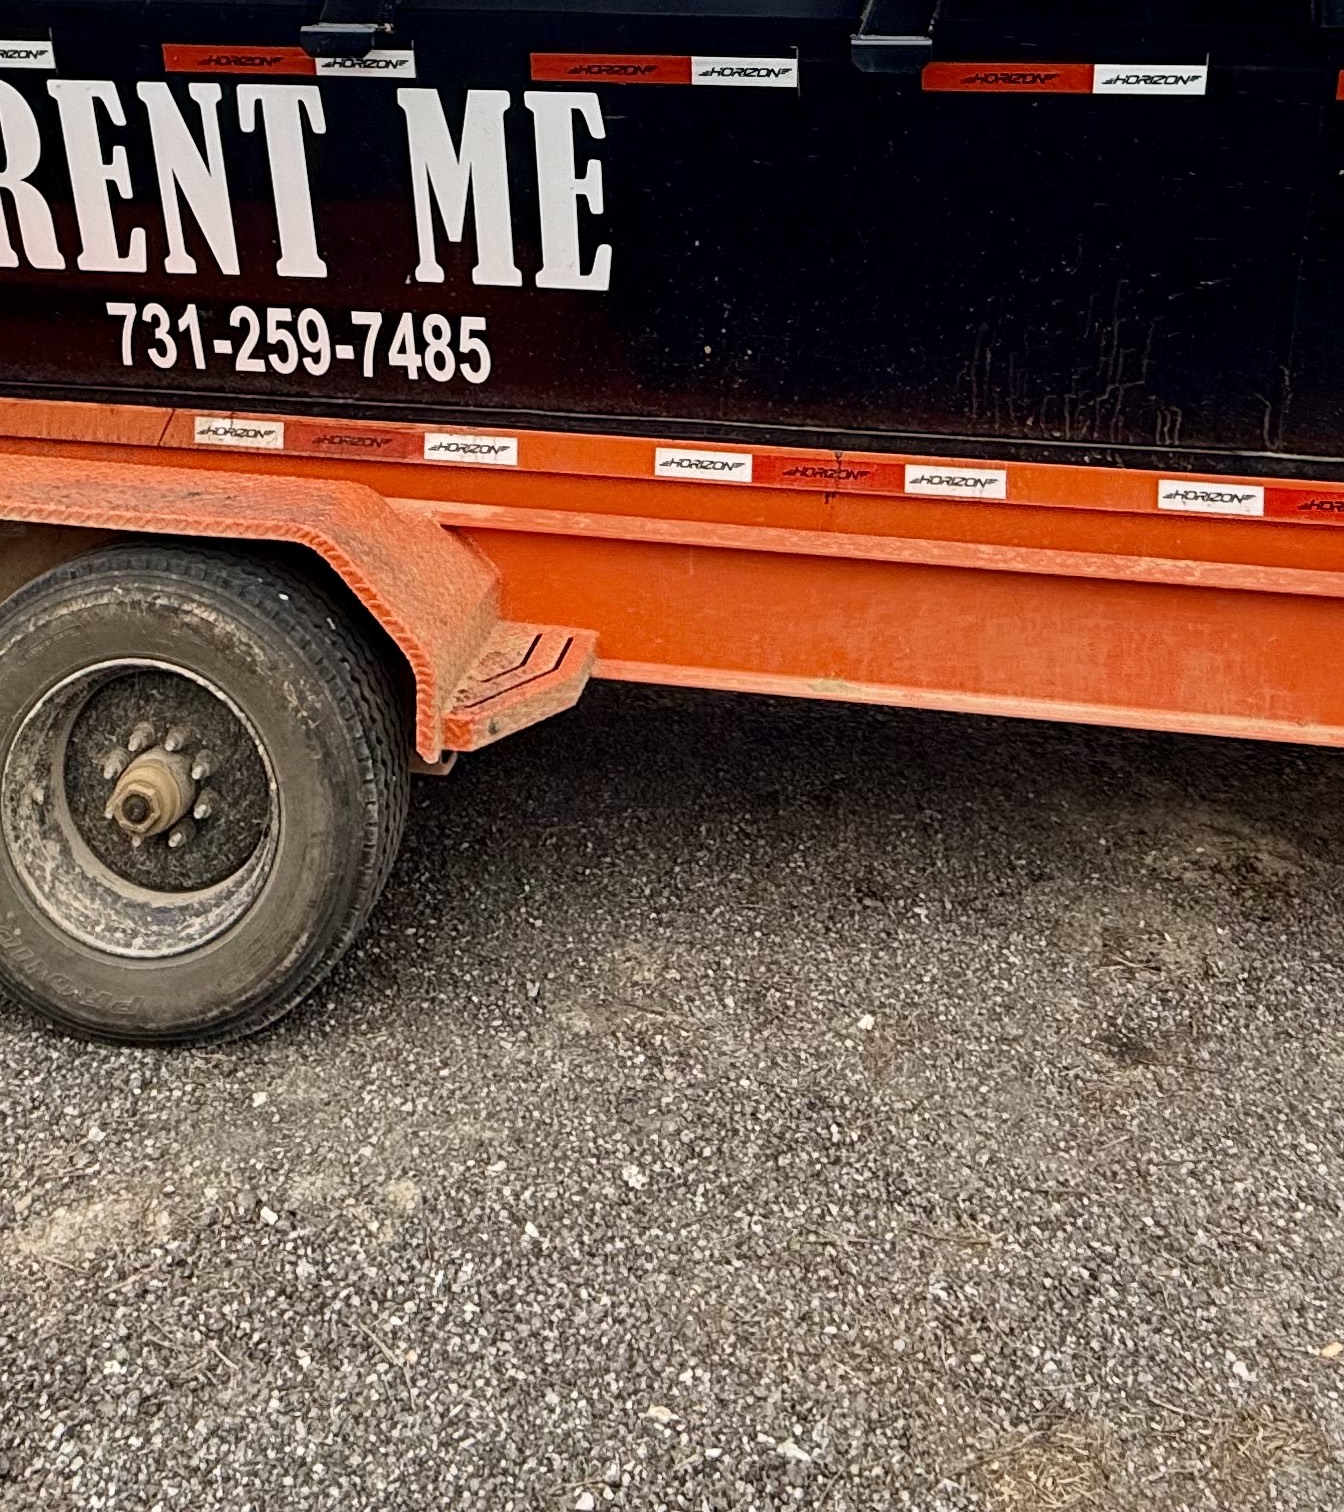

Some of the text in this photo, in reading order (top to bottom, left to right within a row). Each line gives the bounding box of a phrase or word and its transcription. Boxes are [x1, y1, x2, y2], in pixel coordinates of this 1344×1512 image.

[206, 55, 274, 67] HORIZON
[331, 57, 400, 70] HORIZON
[576, 64, 650, 76] HORIZON
[708, 67, 782, 79] HORIZON
[972, 72, 1048, 85] HORIZON
[1113, 74, 1192, 86] HORIZON
[396, 87, 612, 290] ME
[106, 301, 491, 384] 731-259-7485
[205, 425, 268, 439] HORIZON
[320, 434, 386, 449] HORIZON
[437, 441, 502, 455] HORIZON
[666, 457, 736, 472] HORIZON
[793, 466, 862, 481] HORIZON
[918, 474, 989, 489] HORIZON
[1171, 489, 1246, 505] HORIZON
